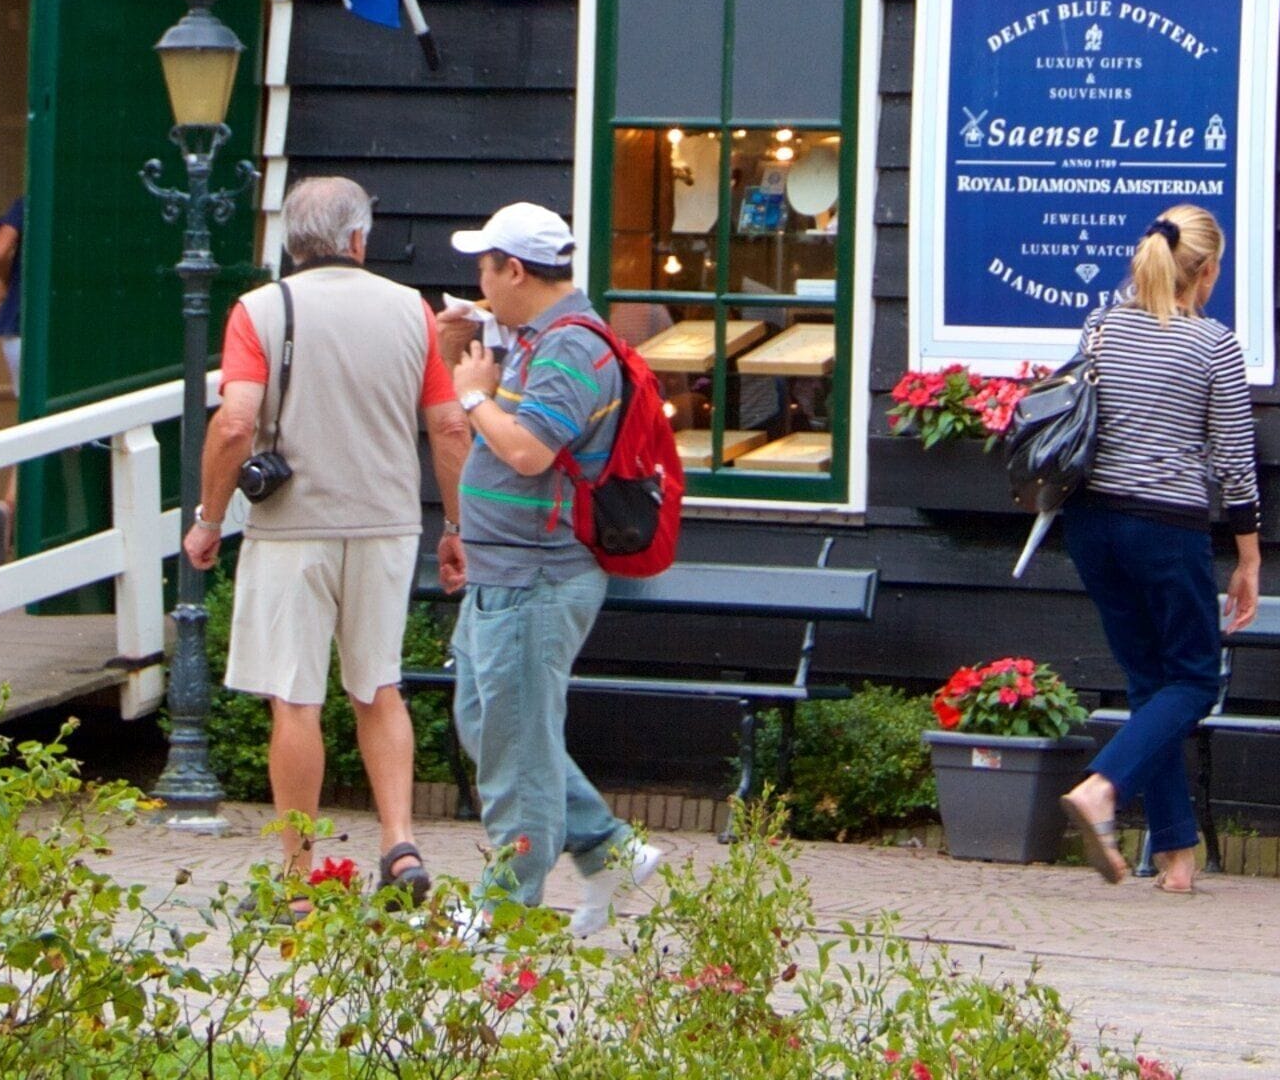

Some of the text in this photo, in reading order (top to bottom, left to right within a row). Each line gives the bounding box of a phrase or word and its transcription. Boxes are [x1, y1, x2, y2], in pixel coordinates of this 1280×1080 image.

[987, 1, 1209, 61] DELFT BLUE POTTERY
[1036, 57, 1143, 69] LUXURY GIFTS
[1085, 72, 1096, 84] &
[1049, 88, 1132, 100] SOUVENIRS
[987, 118, 1195, 149] Saense Lelie
[1061, 159, 1092, 169] ANNO
[957, 175, 1224, 195] ROYAL DIAMONDS AMSTERDAM
[1042, 213, 1127, 226] JEWELLERY
[1078, 229, 1090, 240] &
[1021, 243, 1136, 257] LUXURY WATCH
[987, 257, 1089, 308] DIAMOND
